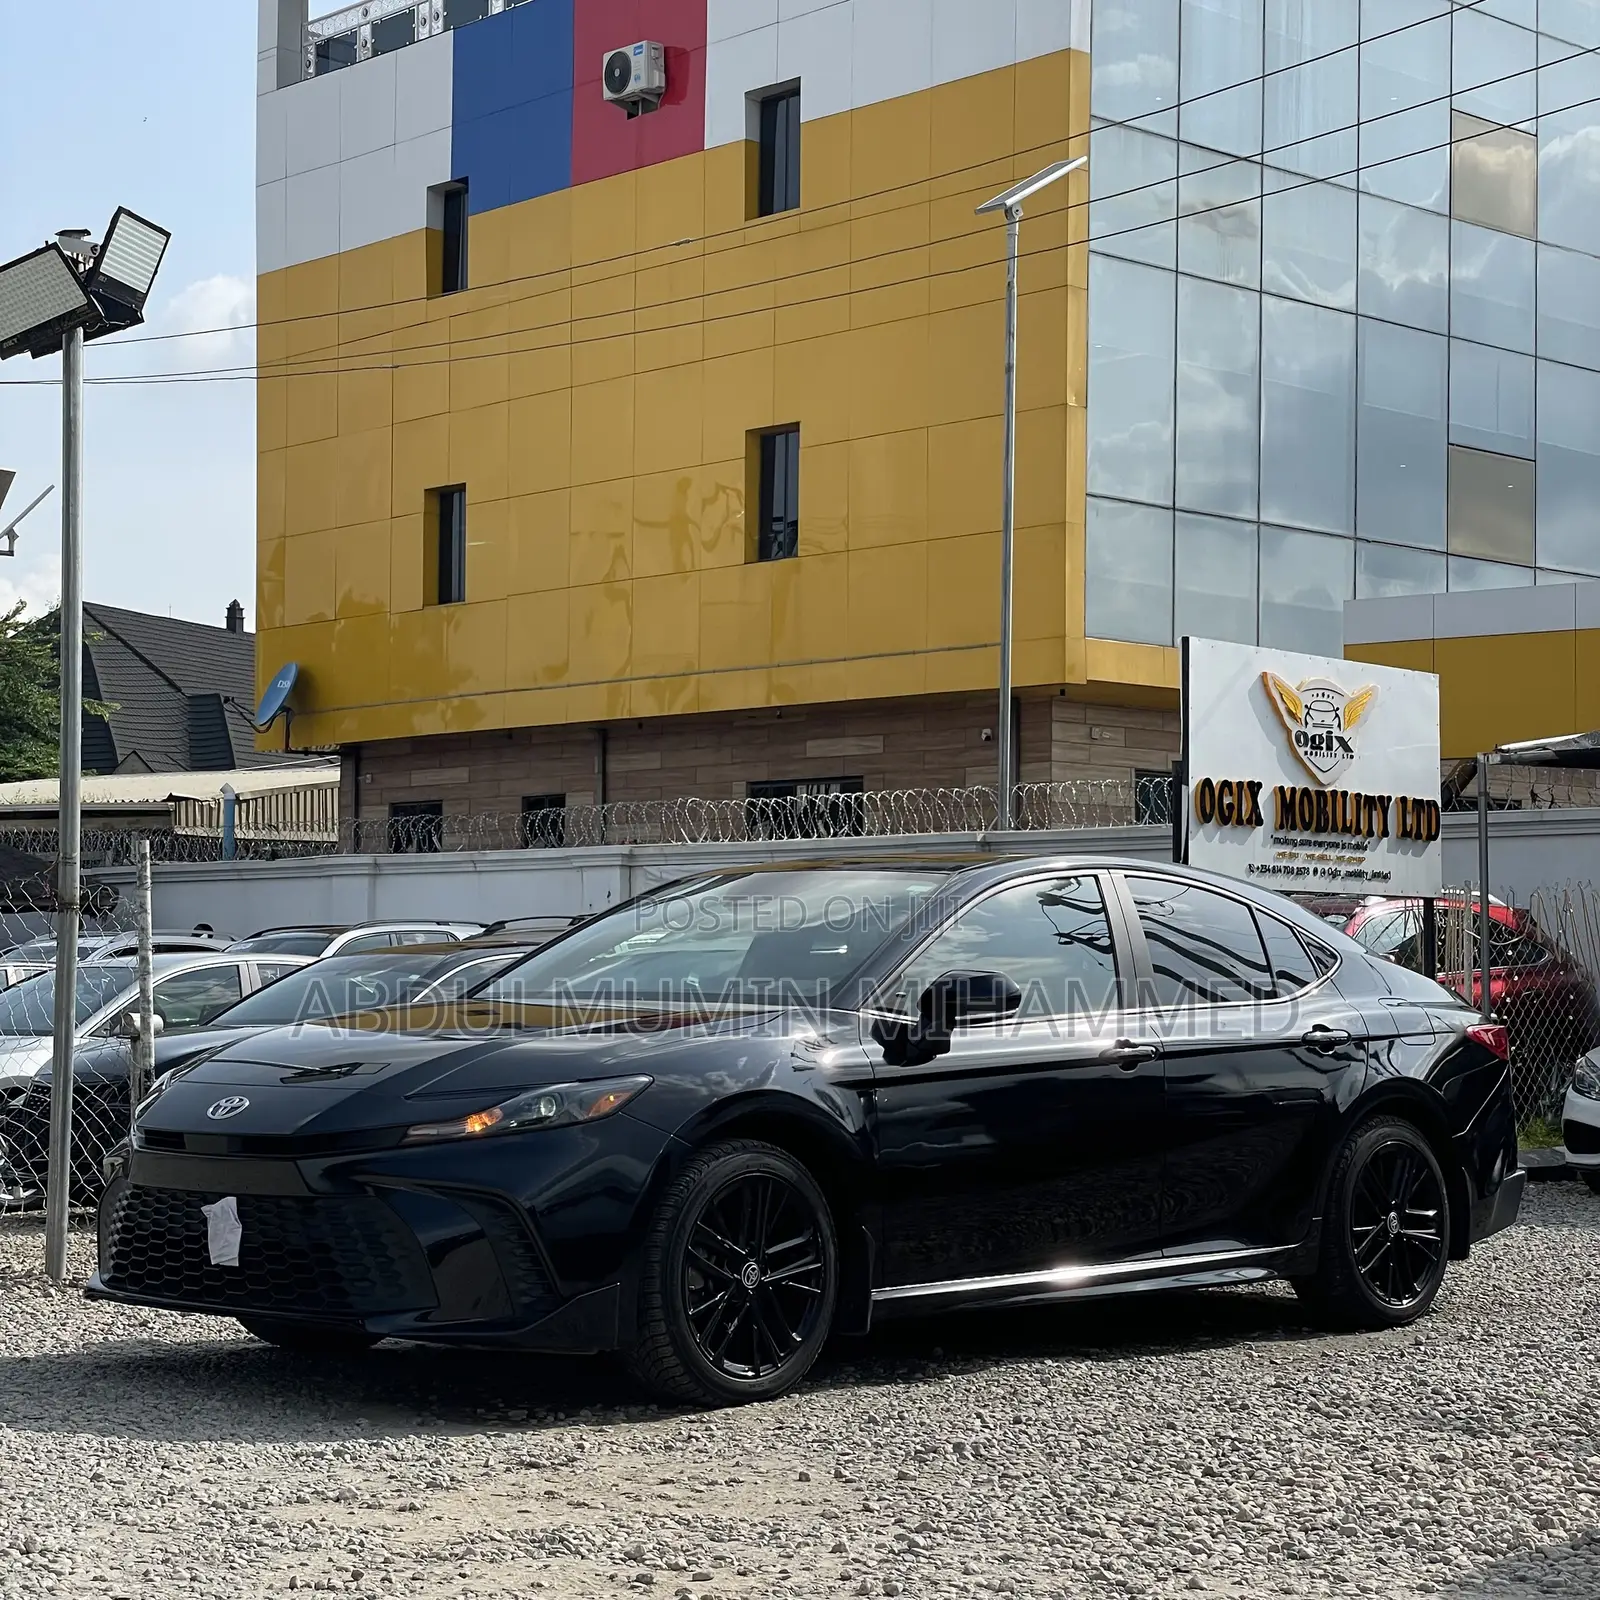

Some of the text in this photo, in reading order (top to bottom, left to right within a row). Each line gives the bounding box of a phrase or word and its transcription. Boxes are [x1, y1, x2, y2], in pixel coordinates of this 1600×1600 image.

[1294, 730, 1354, 753] Ogix
[1195, 777, 1441, 841] OGIX MOBILITY LTD
